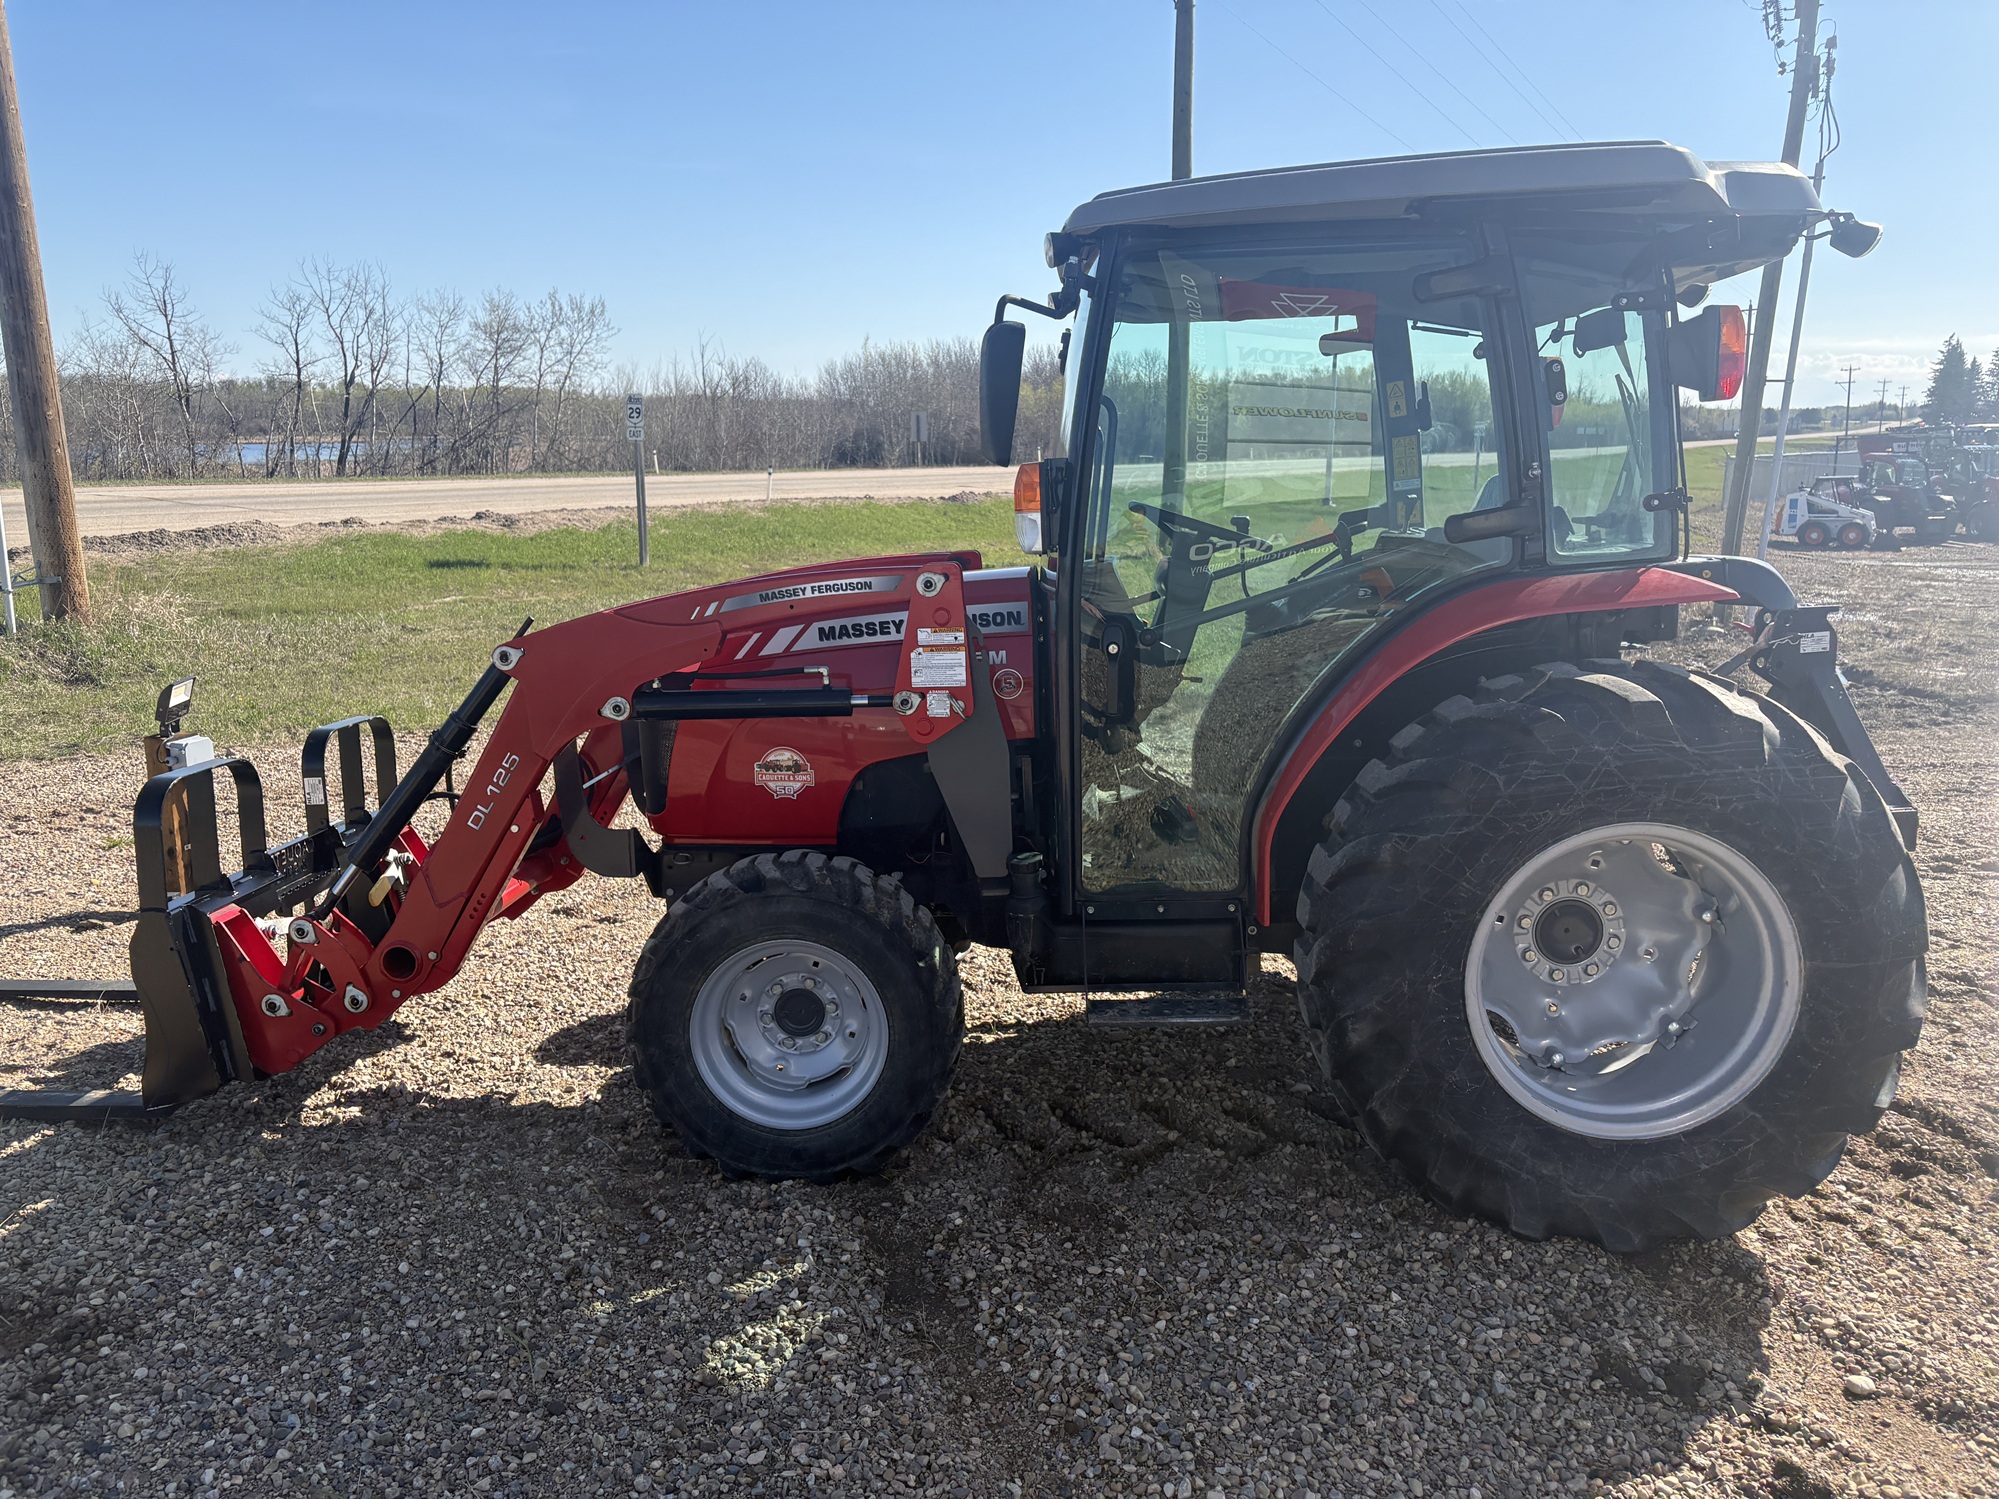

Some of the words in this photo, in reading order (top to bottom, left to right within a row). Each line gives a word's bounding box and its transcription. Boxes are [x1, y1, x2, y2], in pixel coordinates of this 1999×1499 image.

[628, 407, 641, 419] 29
[628, 429, 641, 438] EAST
[759, 585, 807, 603] MASSEY
[810, 581, 873, 596] FERGUSON
[817, 619, 904, 642] MASSEY
[467, 802, 494, 830] DL
[486, 752, 520, 796] 125
[776, 786, 794, 795] 50
